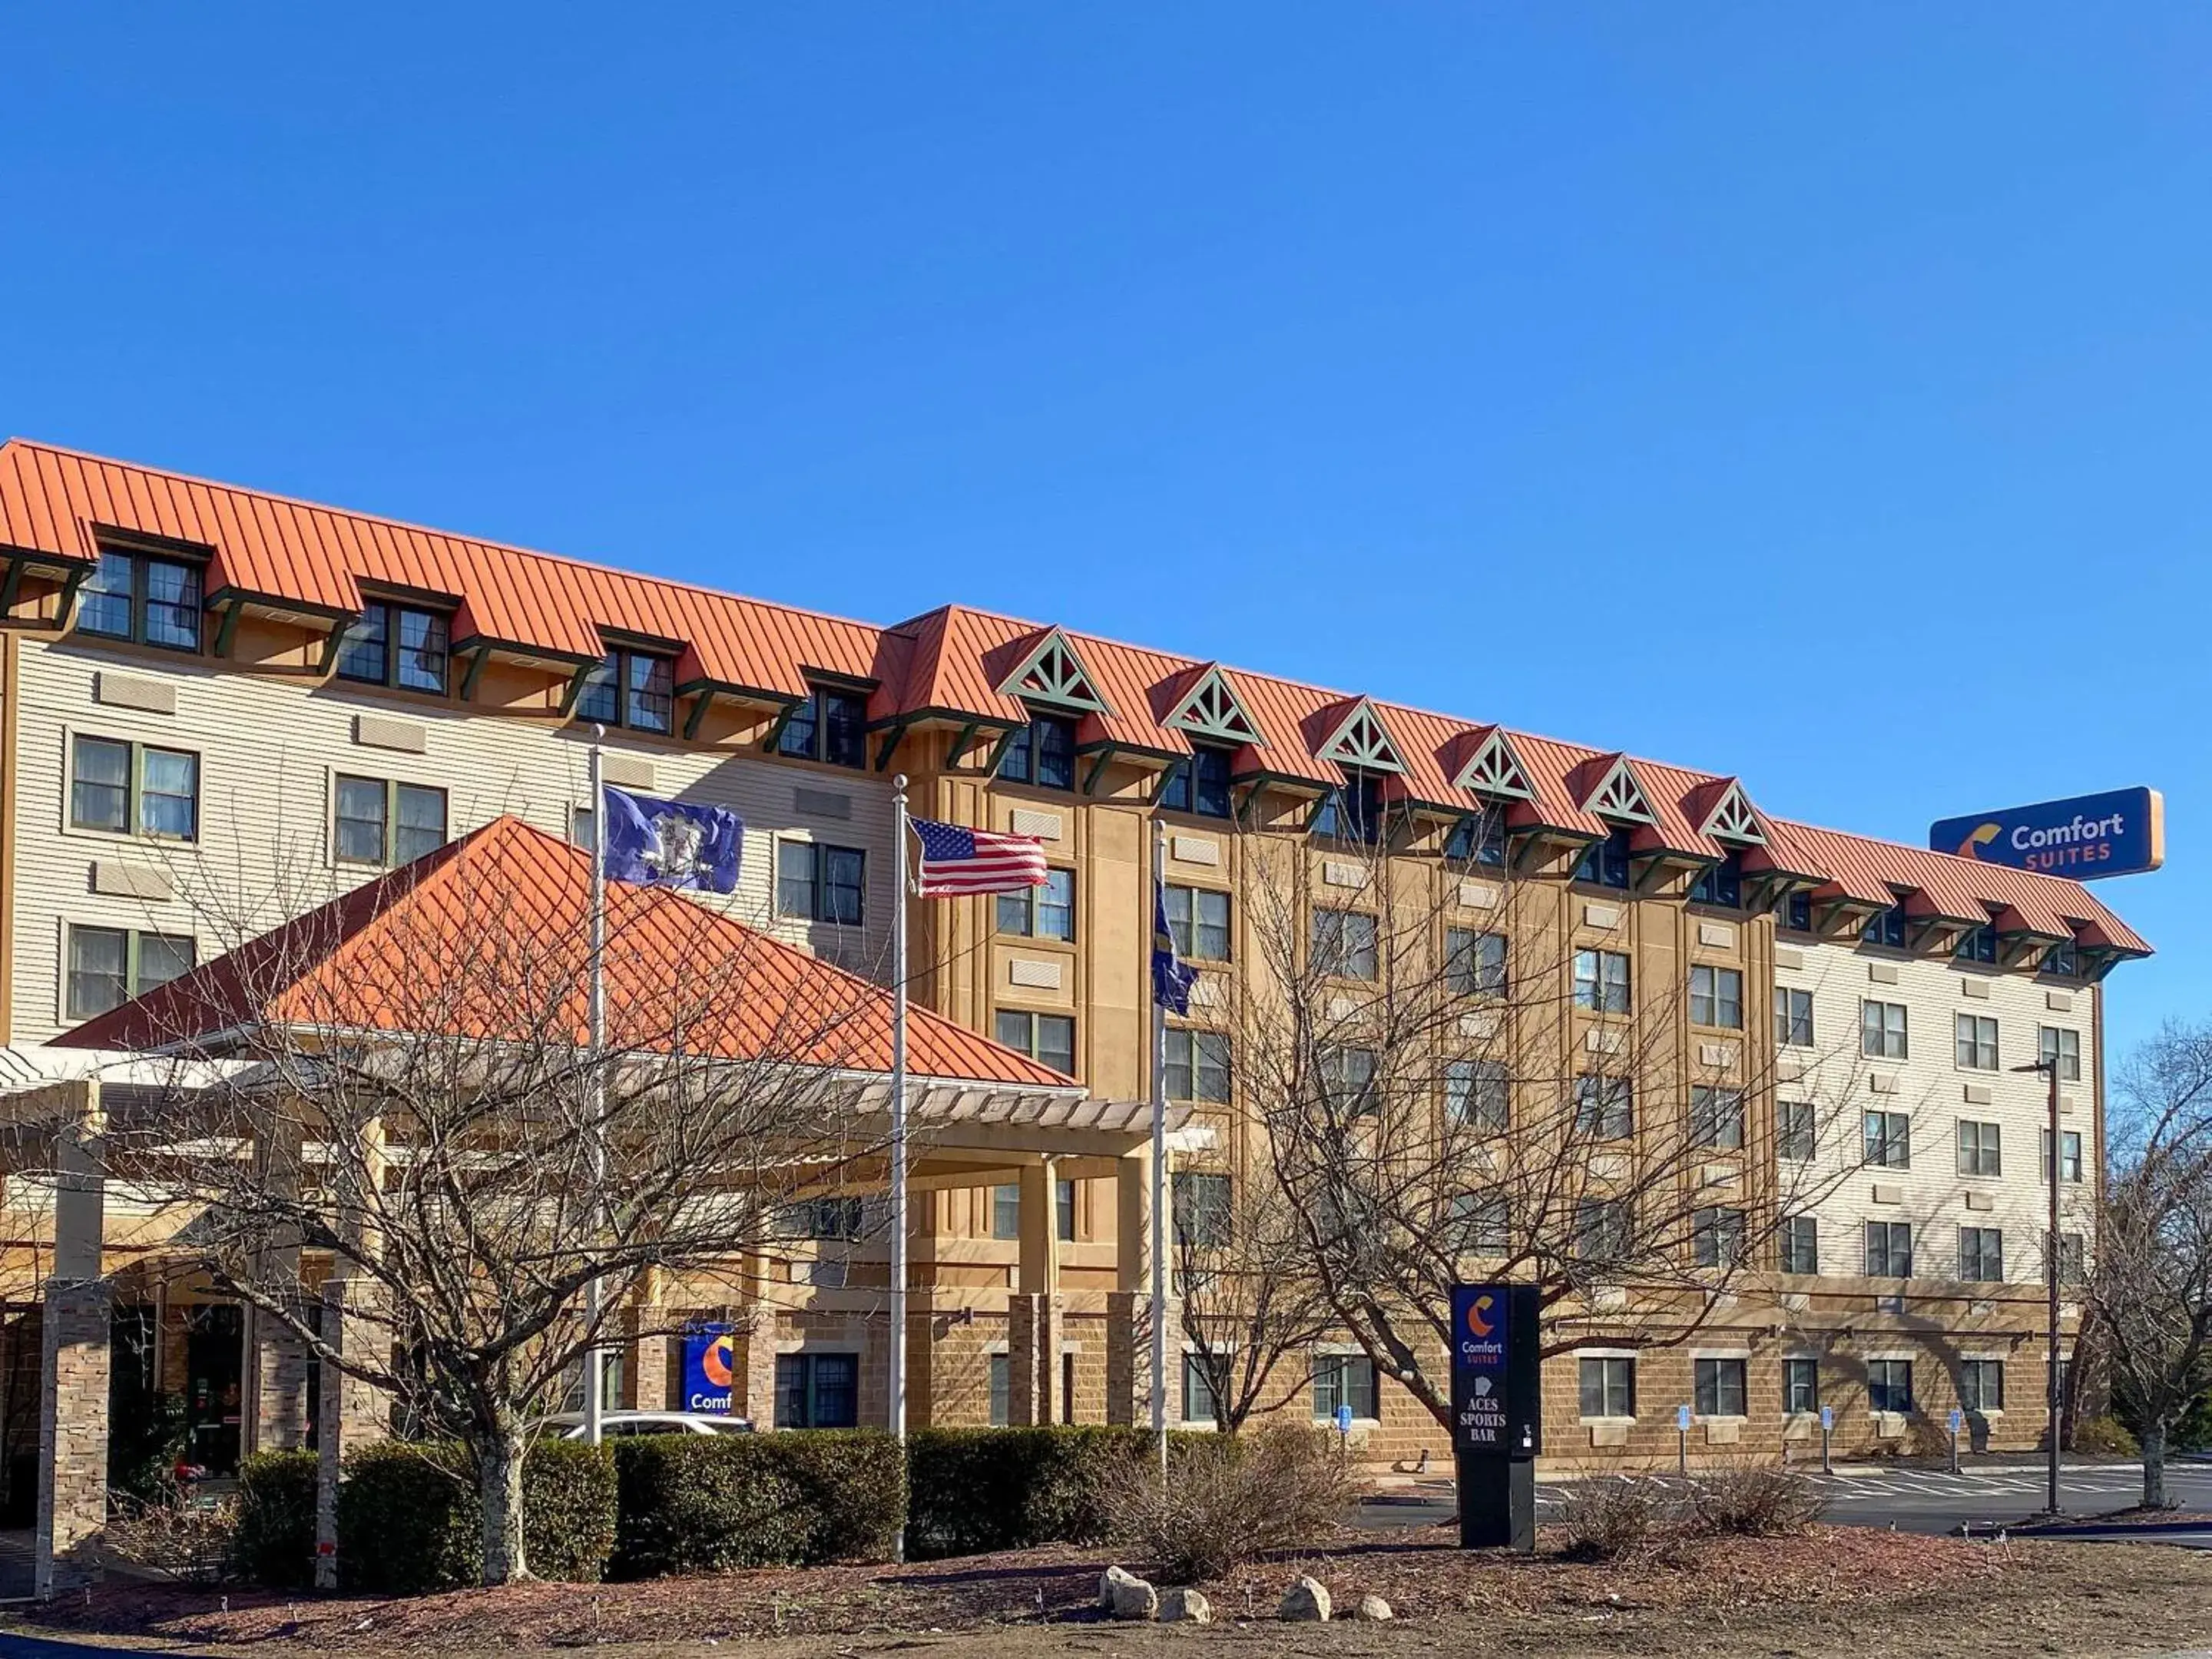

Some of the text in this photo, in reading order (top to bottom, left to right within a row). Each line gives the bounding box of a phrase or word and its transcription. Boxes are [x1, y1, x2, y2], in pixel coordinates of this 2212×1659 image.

[2011, 813, 2124, 850] Comfort
[2025, 843, 2111, 870] SUITES
[1462, 1340, 1502, 1354] Comfort
[691, 1392, 732, 1409] Comf
[1468, 1398, 1498, 1411] ACES
[1460, 1412, 1506, 1427] SPORTS
[1471, 1429, 1496, 1442] BAR
